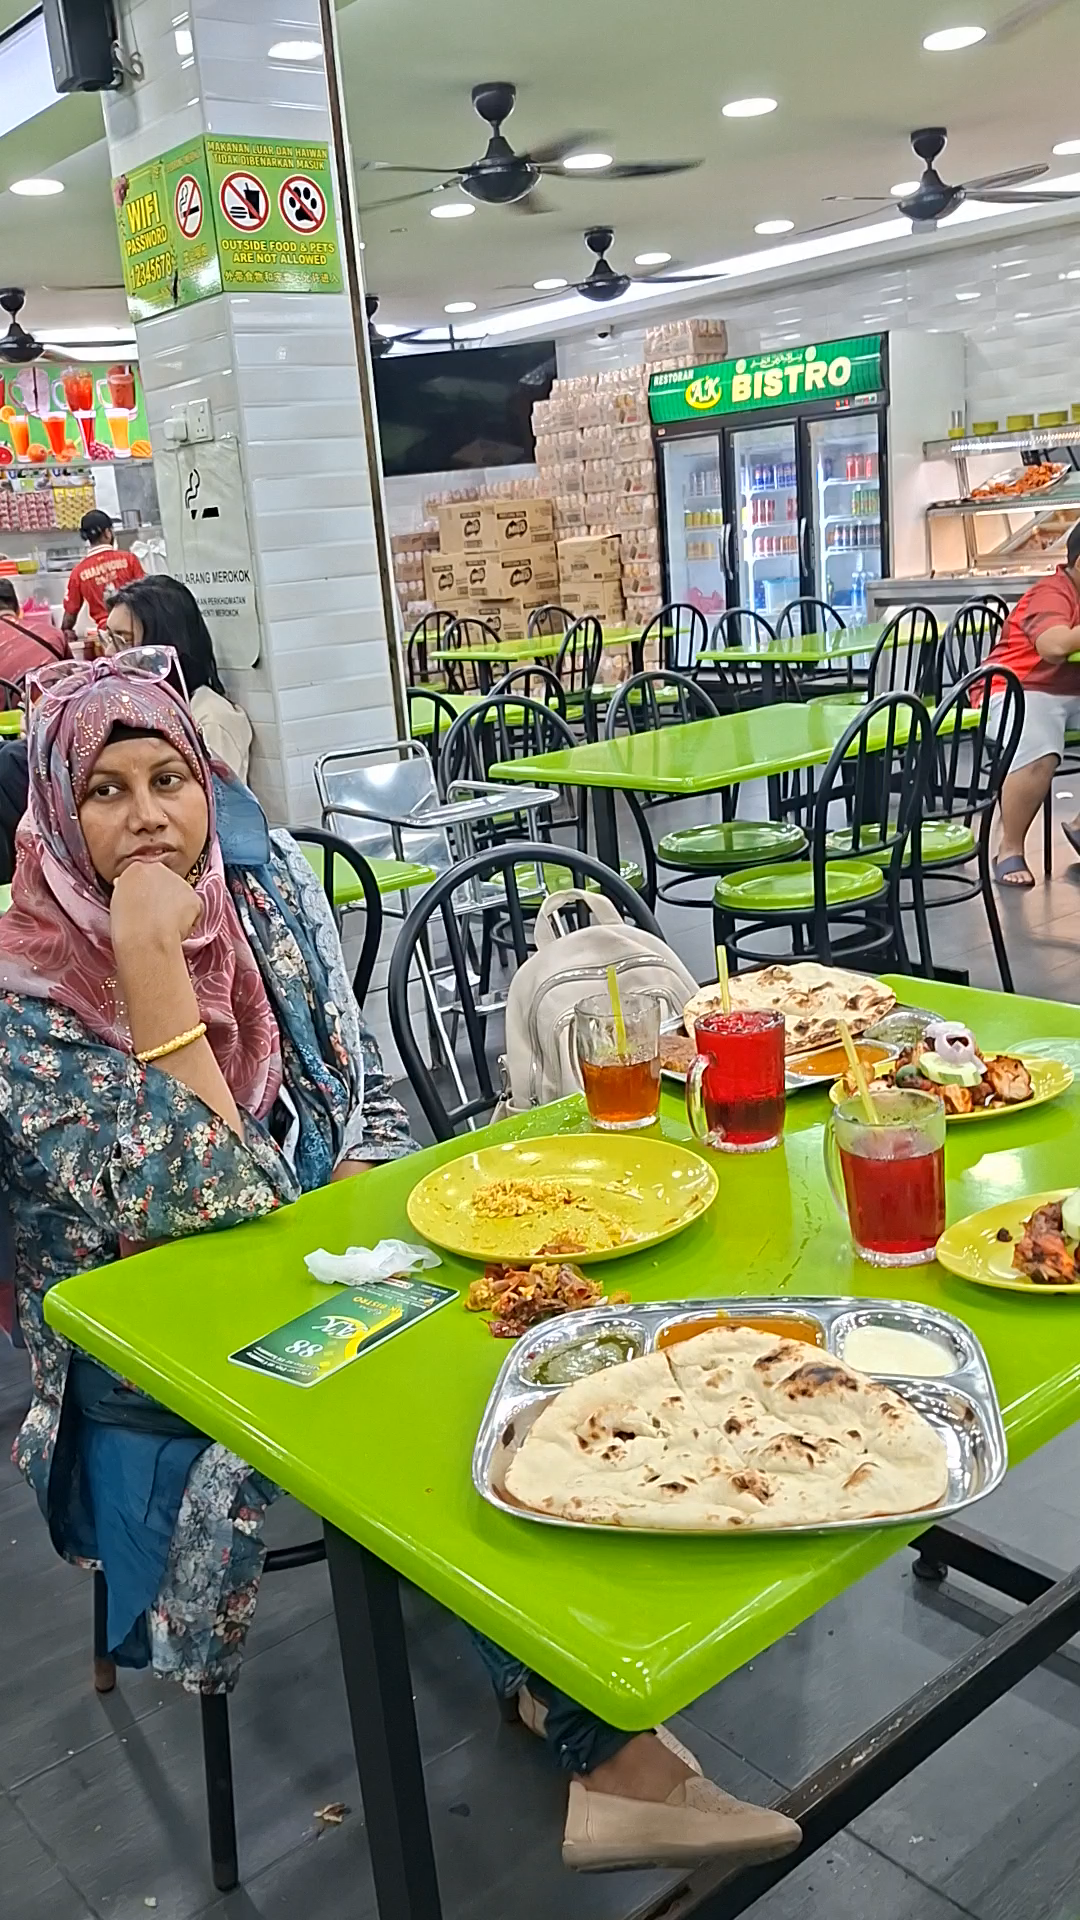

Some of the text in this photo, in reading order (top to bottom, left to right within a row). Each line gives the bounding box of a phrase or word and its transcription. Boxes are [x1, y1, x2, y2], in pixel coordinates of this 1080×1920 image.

[207, 141, 327, 159] MAKANAN LUAR DAN HAIWAN
[212, 153, 238, 164] TIDAK
[240, 155, 294, 168] DIBENARKAN
[297, 160, 324, 170] MASUK
[127, 190, 161, 234] WIFI
[126, 224, 168, 257] PASSWORD
[221, 239, 335, 253] OUTSIDE FOOD & PETS
[233, 253, 327, 265] ARE NOT ALLOWED
[130, 251, 172, 289] 12345678
[653, 369, 695, 387] RESTORAN
[732, 356, 852, 403] BISTRO
[212, 569, 251, 583] MEROKOK
[352, 1296, 387, 1309] BISTRO
[284, 1340, 323, 1357] 88
